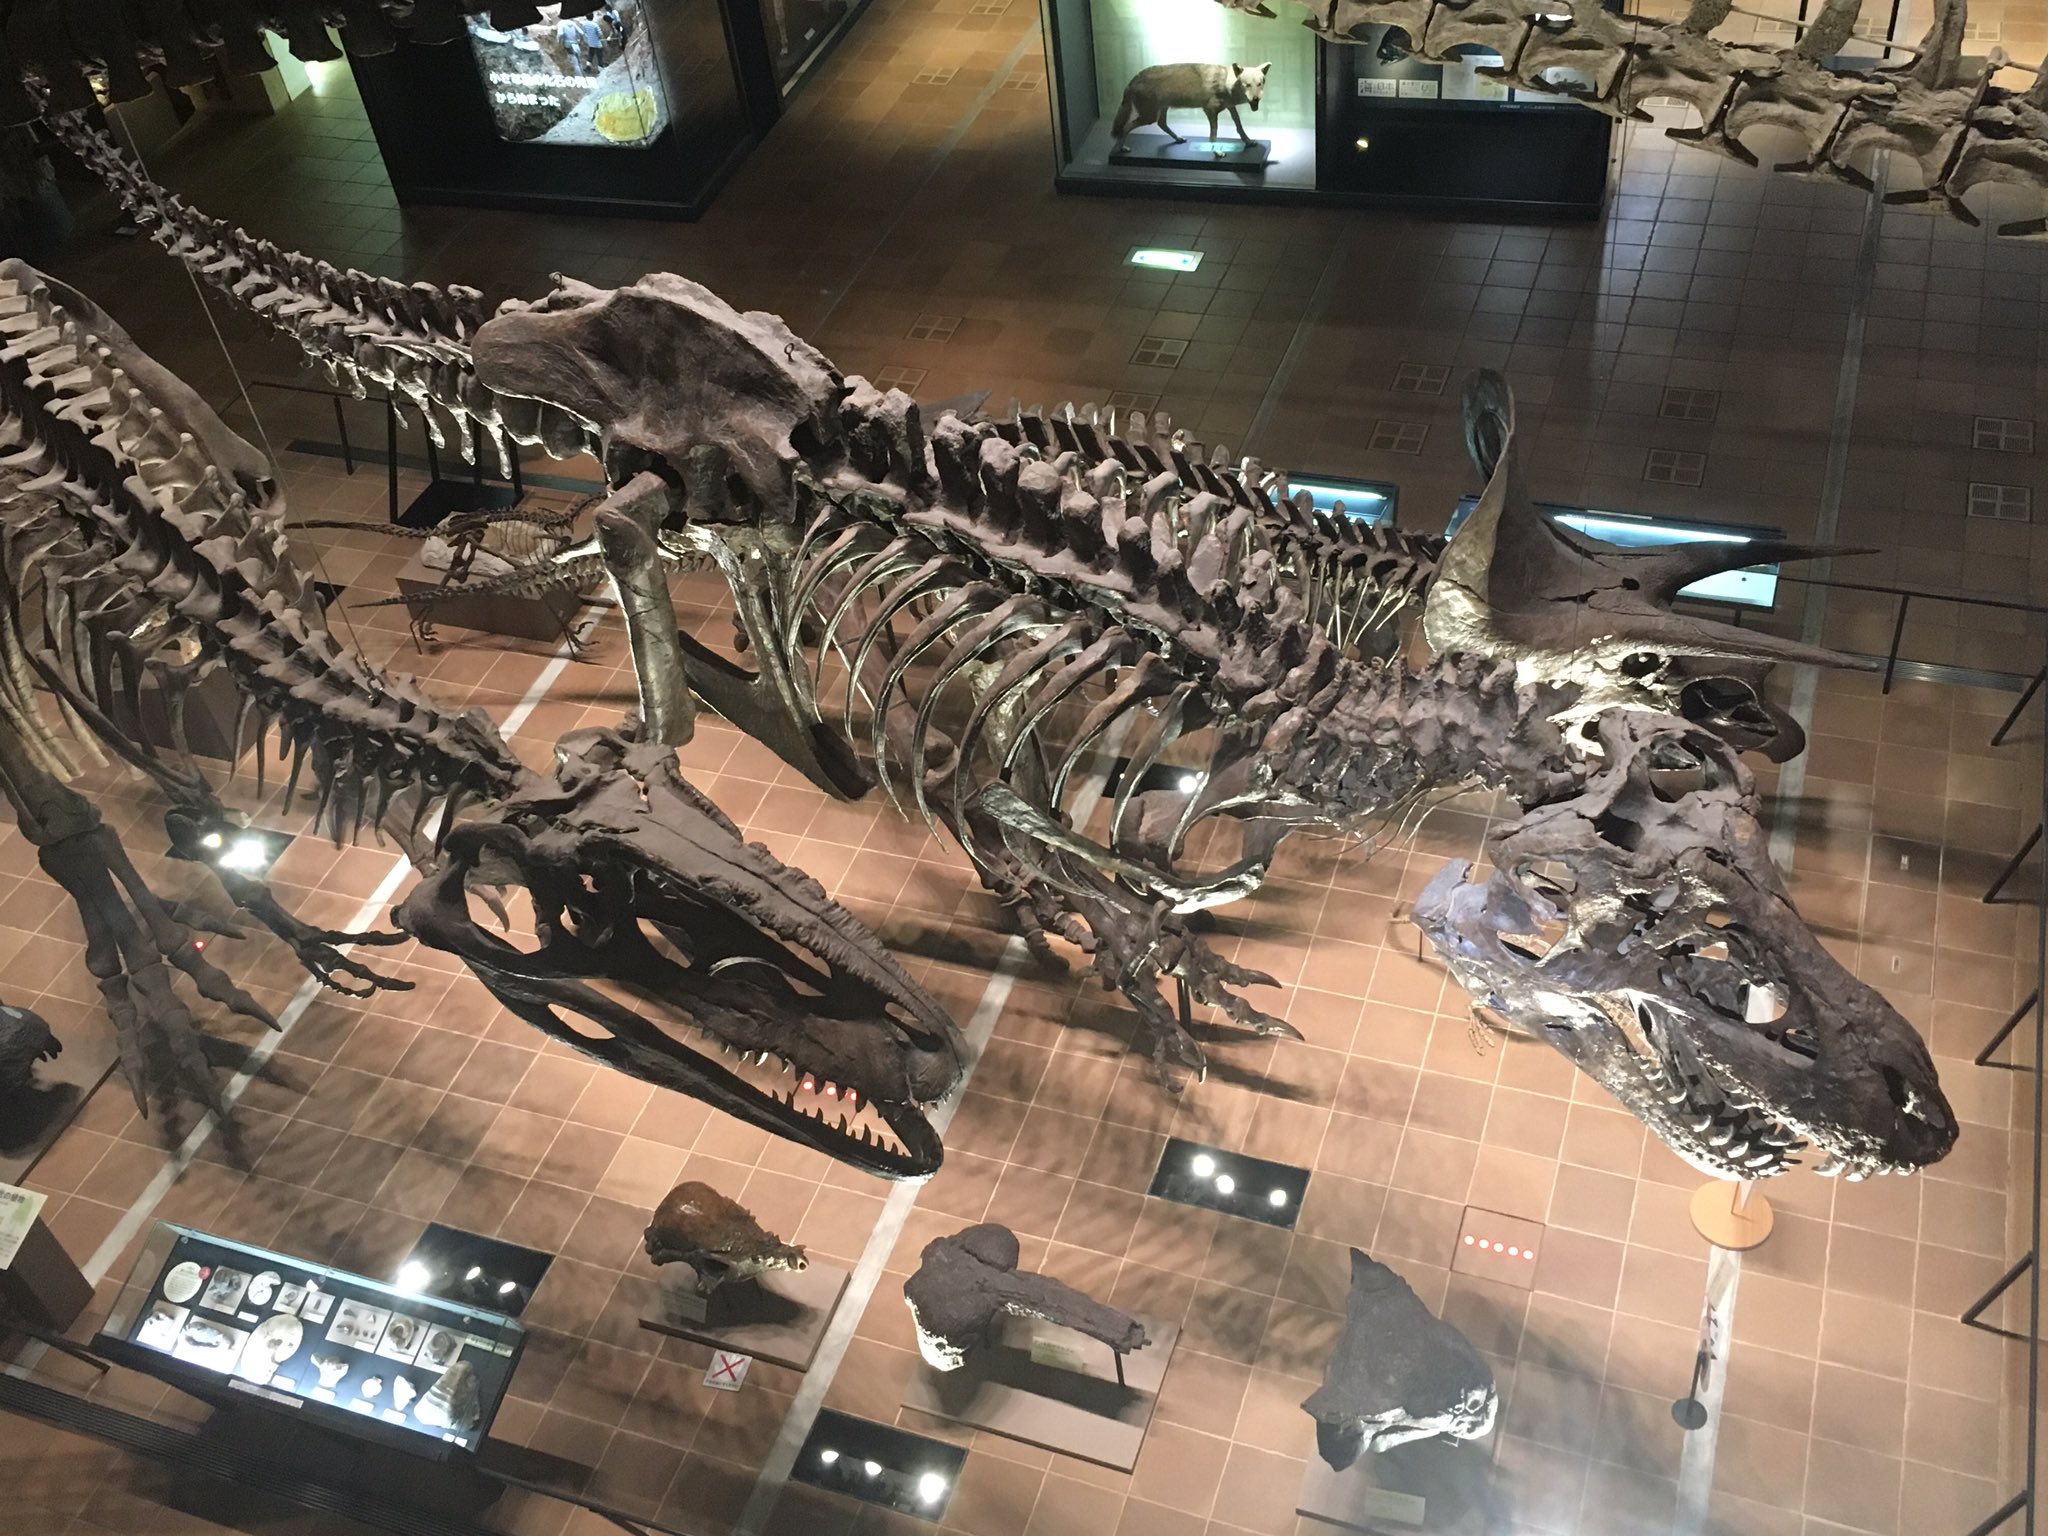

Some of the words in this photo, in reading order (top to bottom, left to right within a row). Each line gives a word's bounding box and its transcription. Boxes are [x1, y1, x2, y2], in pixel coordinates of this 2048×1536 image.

[489, 72, 598, 88] 小さなの化石の発見
[496, 92, 560, 106] から始まった
